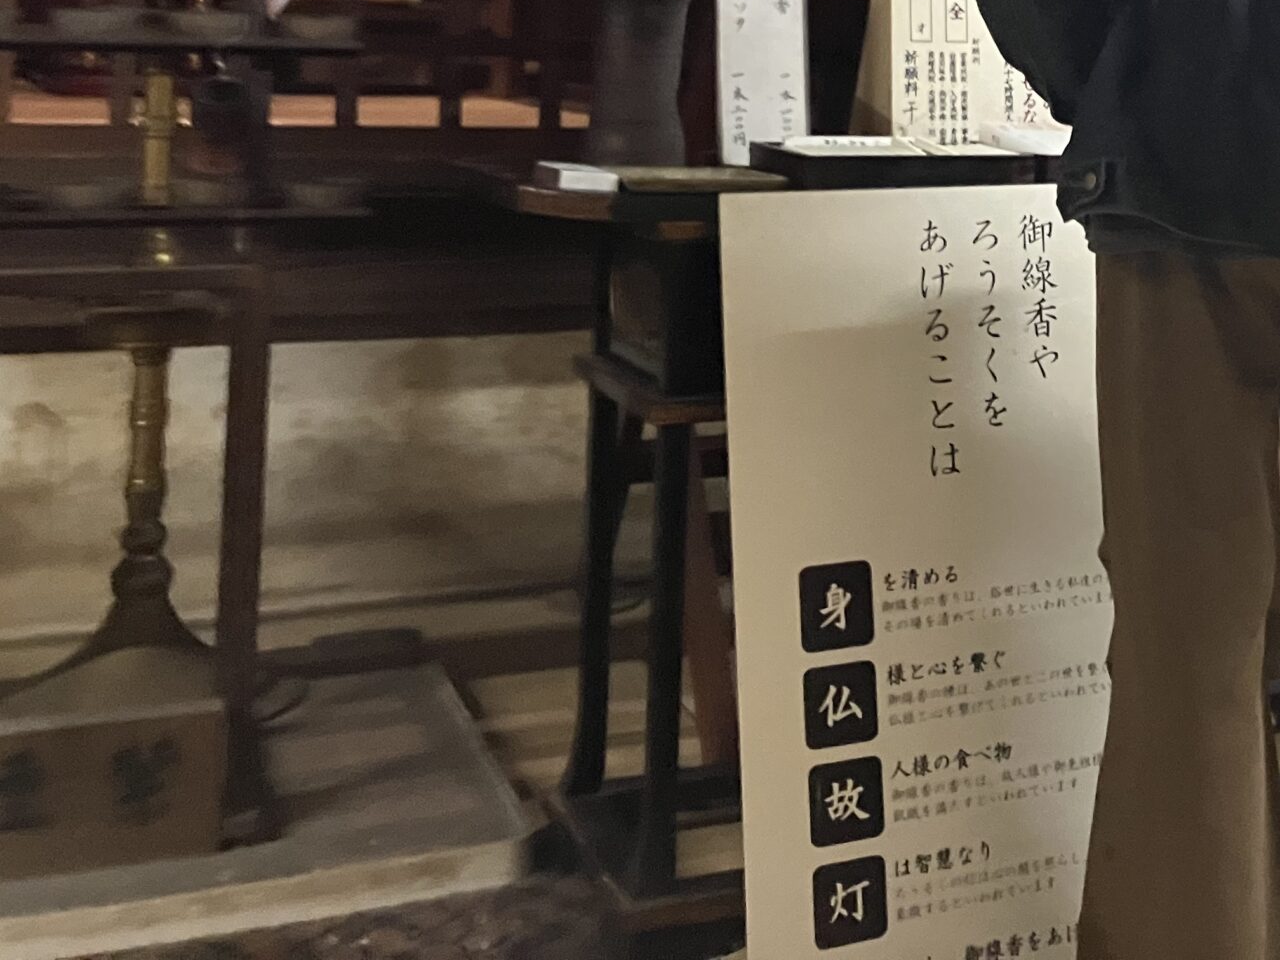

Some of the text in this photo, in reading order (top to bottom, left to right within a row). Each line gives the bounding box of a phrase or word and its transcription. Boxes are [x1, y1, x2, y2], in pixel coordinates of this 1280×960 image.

[972, 220, 1007, 428] ろうそくを
[1020, 214, 1059, 379] 御線香や
[919, 220, 961, 477] あげることは
[819, 566, 959, 630] 身 を清める
[818, 651, 1006, 728] 仏 様と心を繋ぐ
[824, 742, 1013, 822] 故 人様の食べ物
[829, 880, 871, 924] 灯
